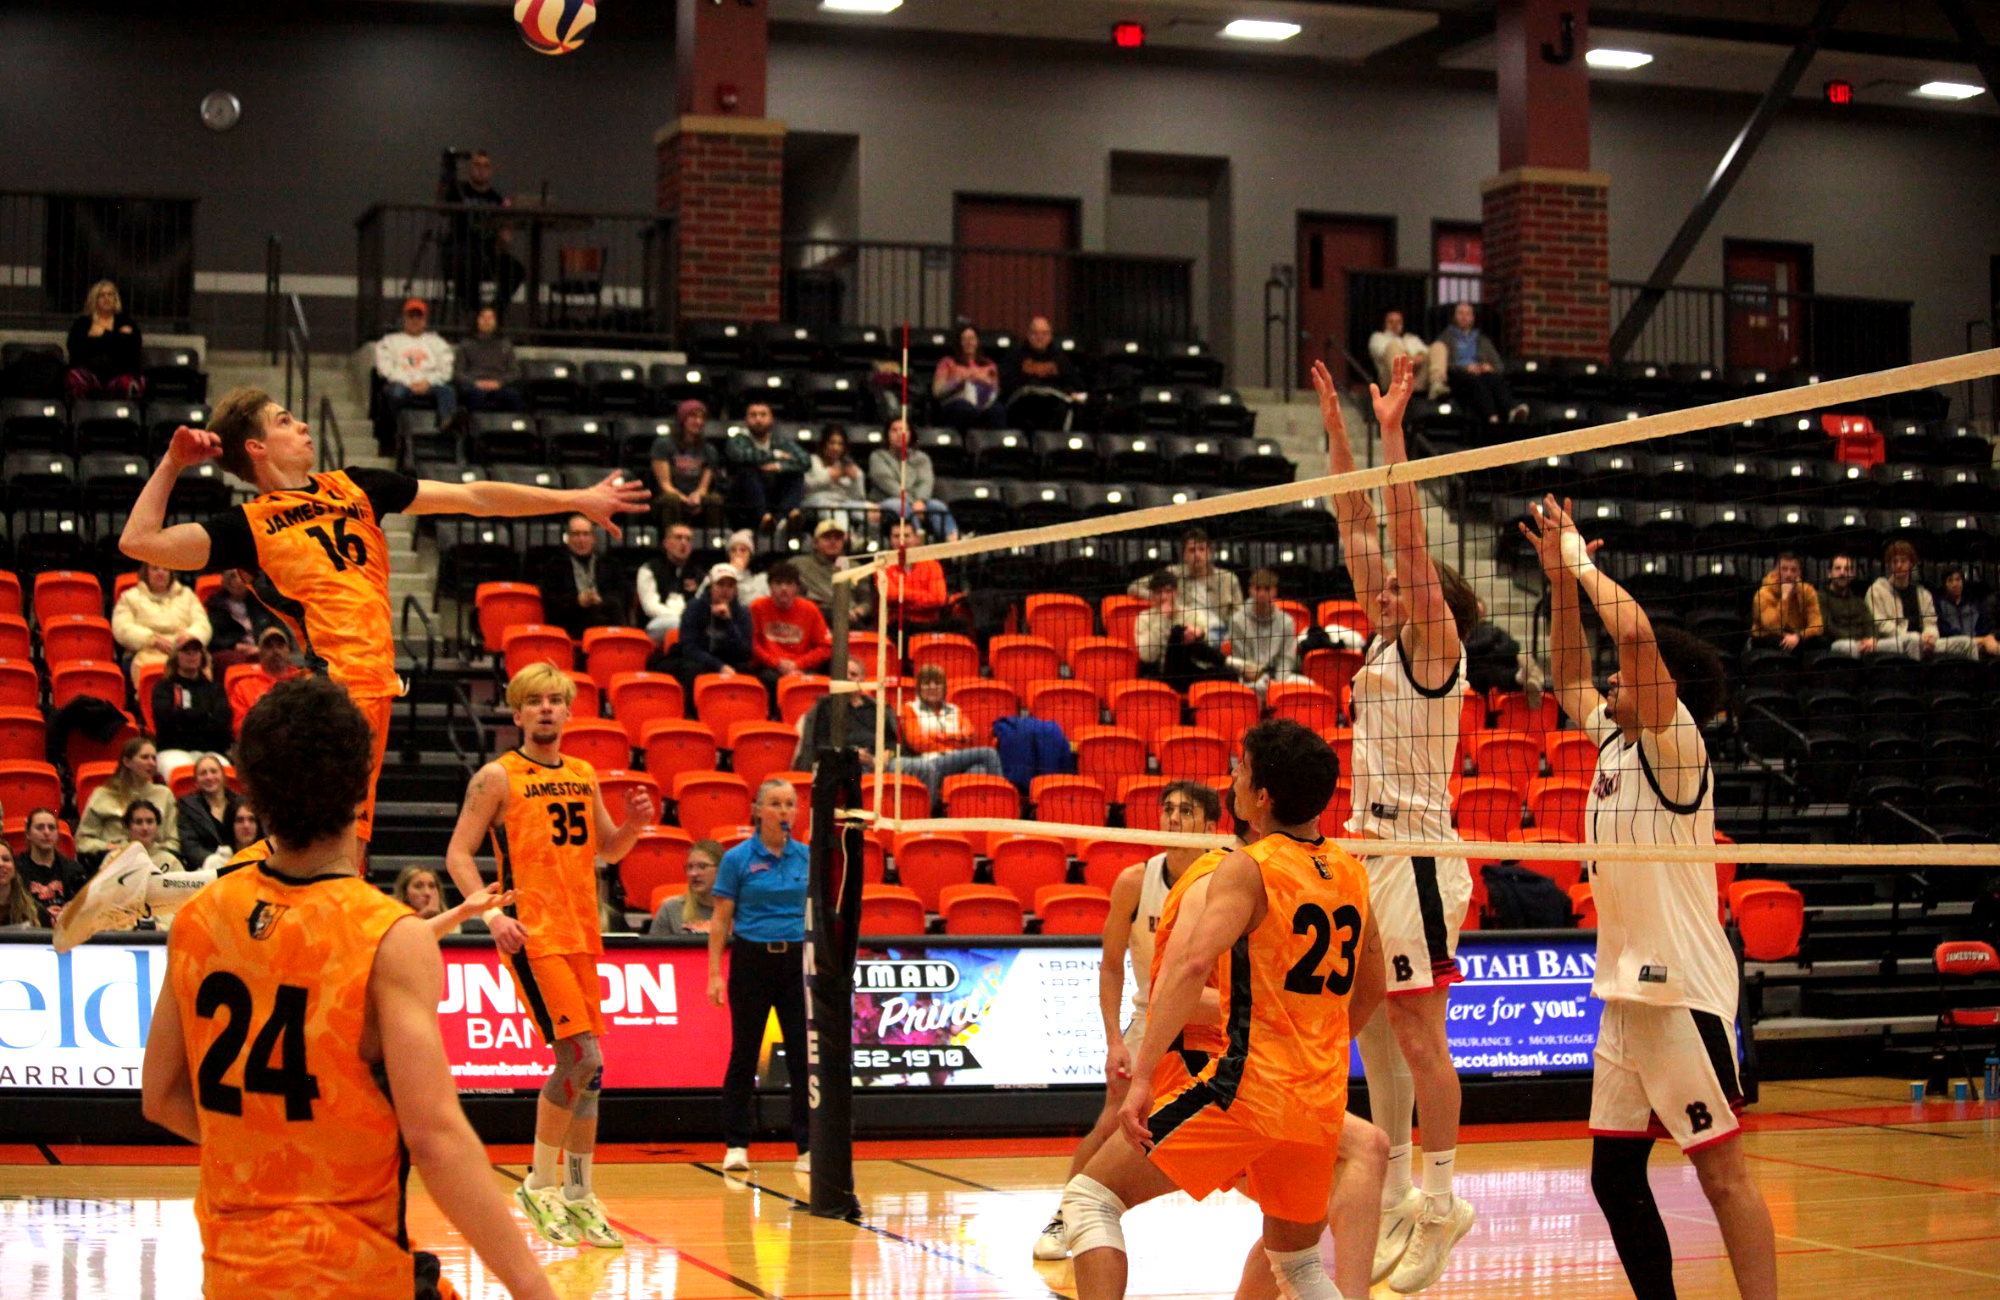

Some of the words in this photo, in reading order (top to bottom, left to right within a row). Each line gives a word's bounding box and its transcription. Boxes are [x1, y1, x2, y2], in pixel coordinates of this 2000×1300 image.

[1830, 84, 1850, 104] EXIT
[304, 516, 367, 572] 16
[546, 801, 589, 846] 35
[1284, 902, 1362, 996] 23
[1945, 951, 1990, 962] JAMESTOWN
[1392, 954, 1413, 982] B
[1487, 996, 1526, 1026] for
[196, 971, 320, 1122] 24
[1529, 1034, 1595, 1046] MORTGAGE
[1685, 1101, 1713, 1134] B
